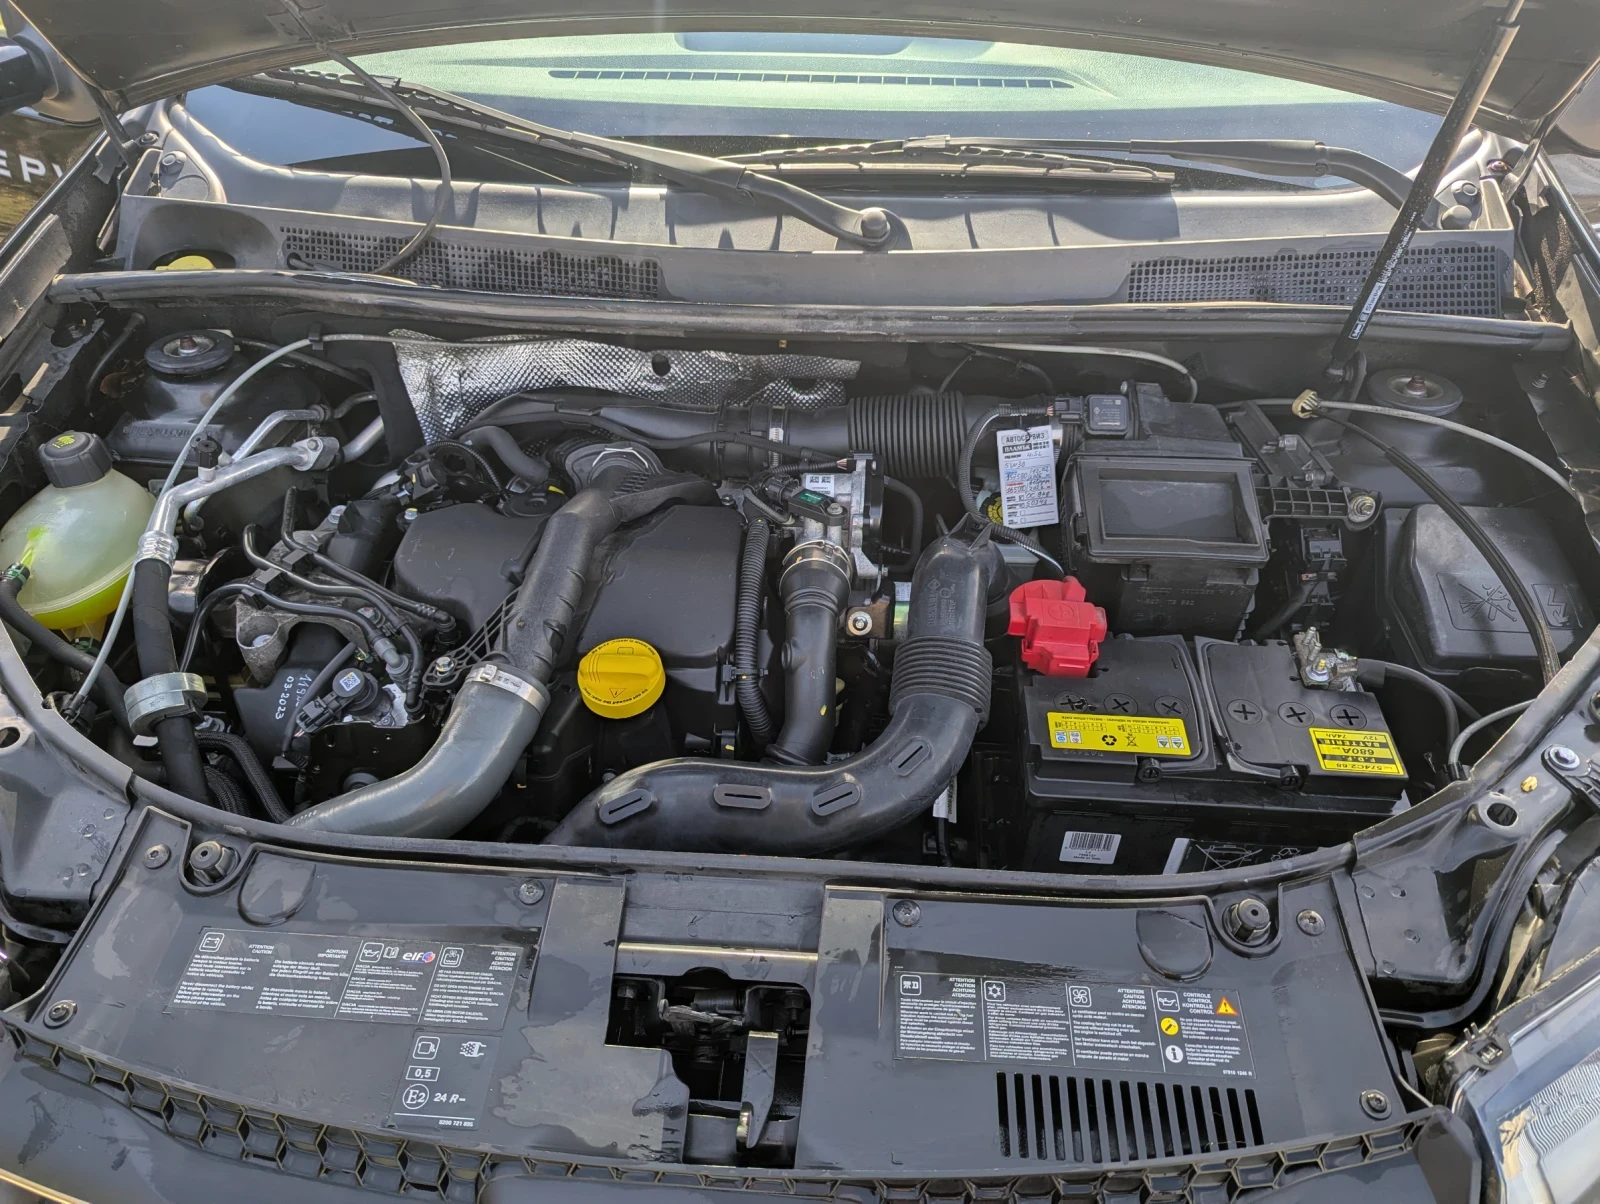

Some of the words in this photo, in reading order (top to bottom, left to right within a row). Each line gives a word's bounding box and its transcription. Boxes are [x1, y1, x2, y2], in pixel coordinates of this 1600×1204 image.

[275, 676, 294, 720] 03.2023
[1342, 747, 1374, 755] 680A
[403, 952, 423, 960] elf
[415, 1069, 431, 1078] 0,5
[406, 1090, 426, 1104] E2
[433, 1093, 447, 1102] 24
